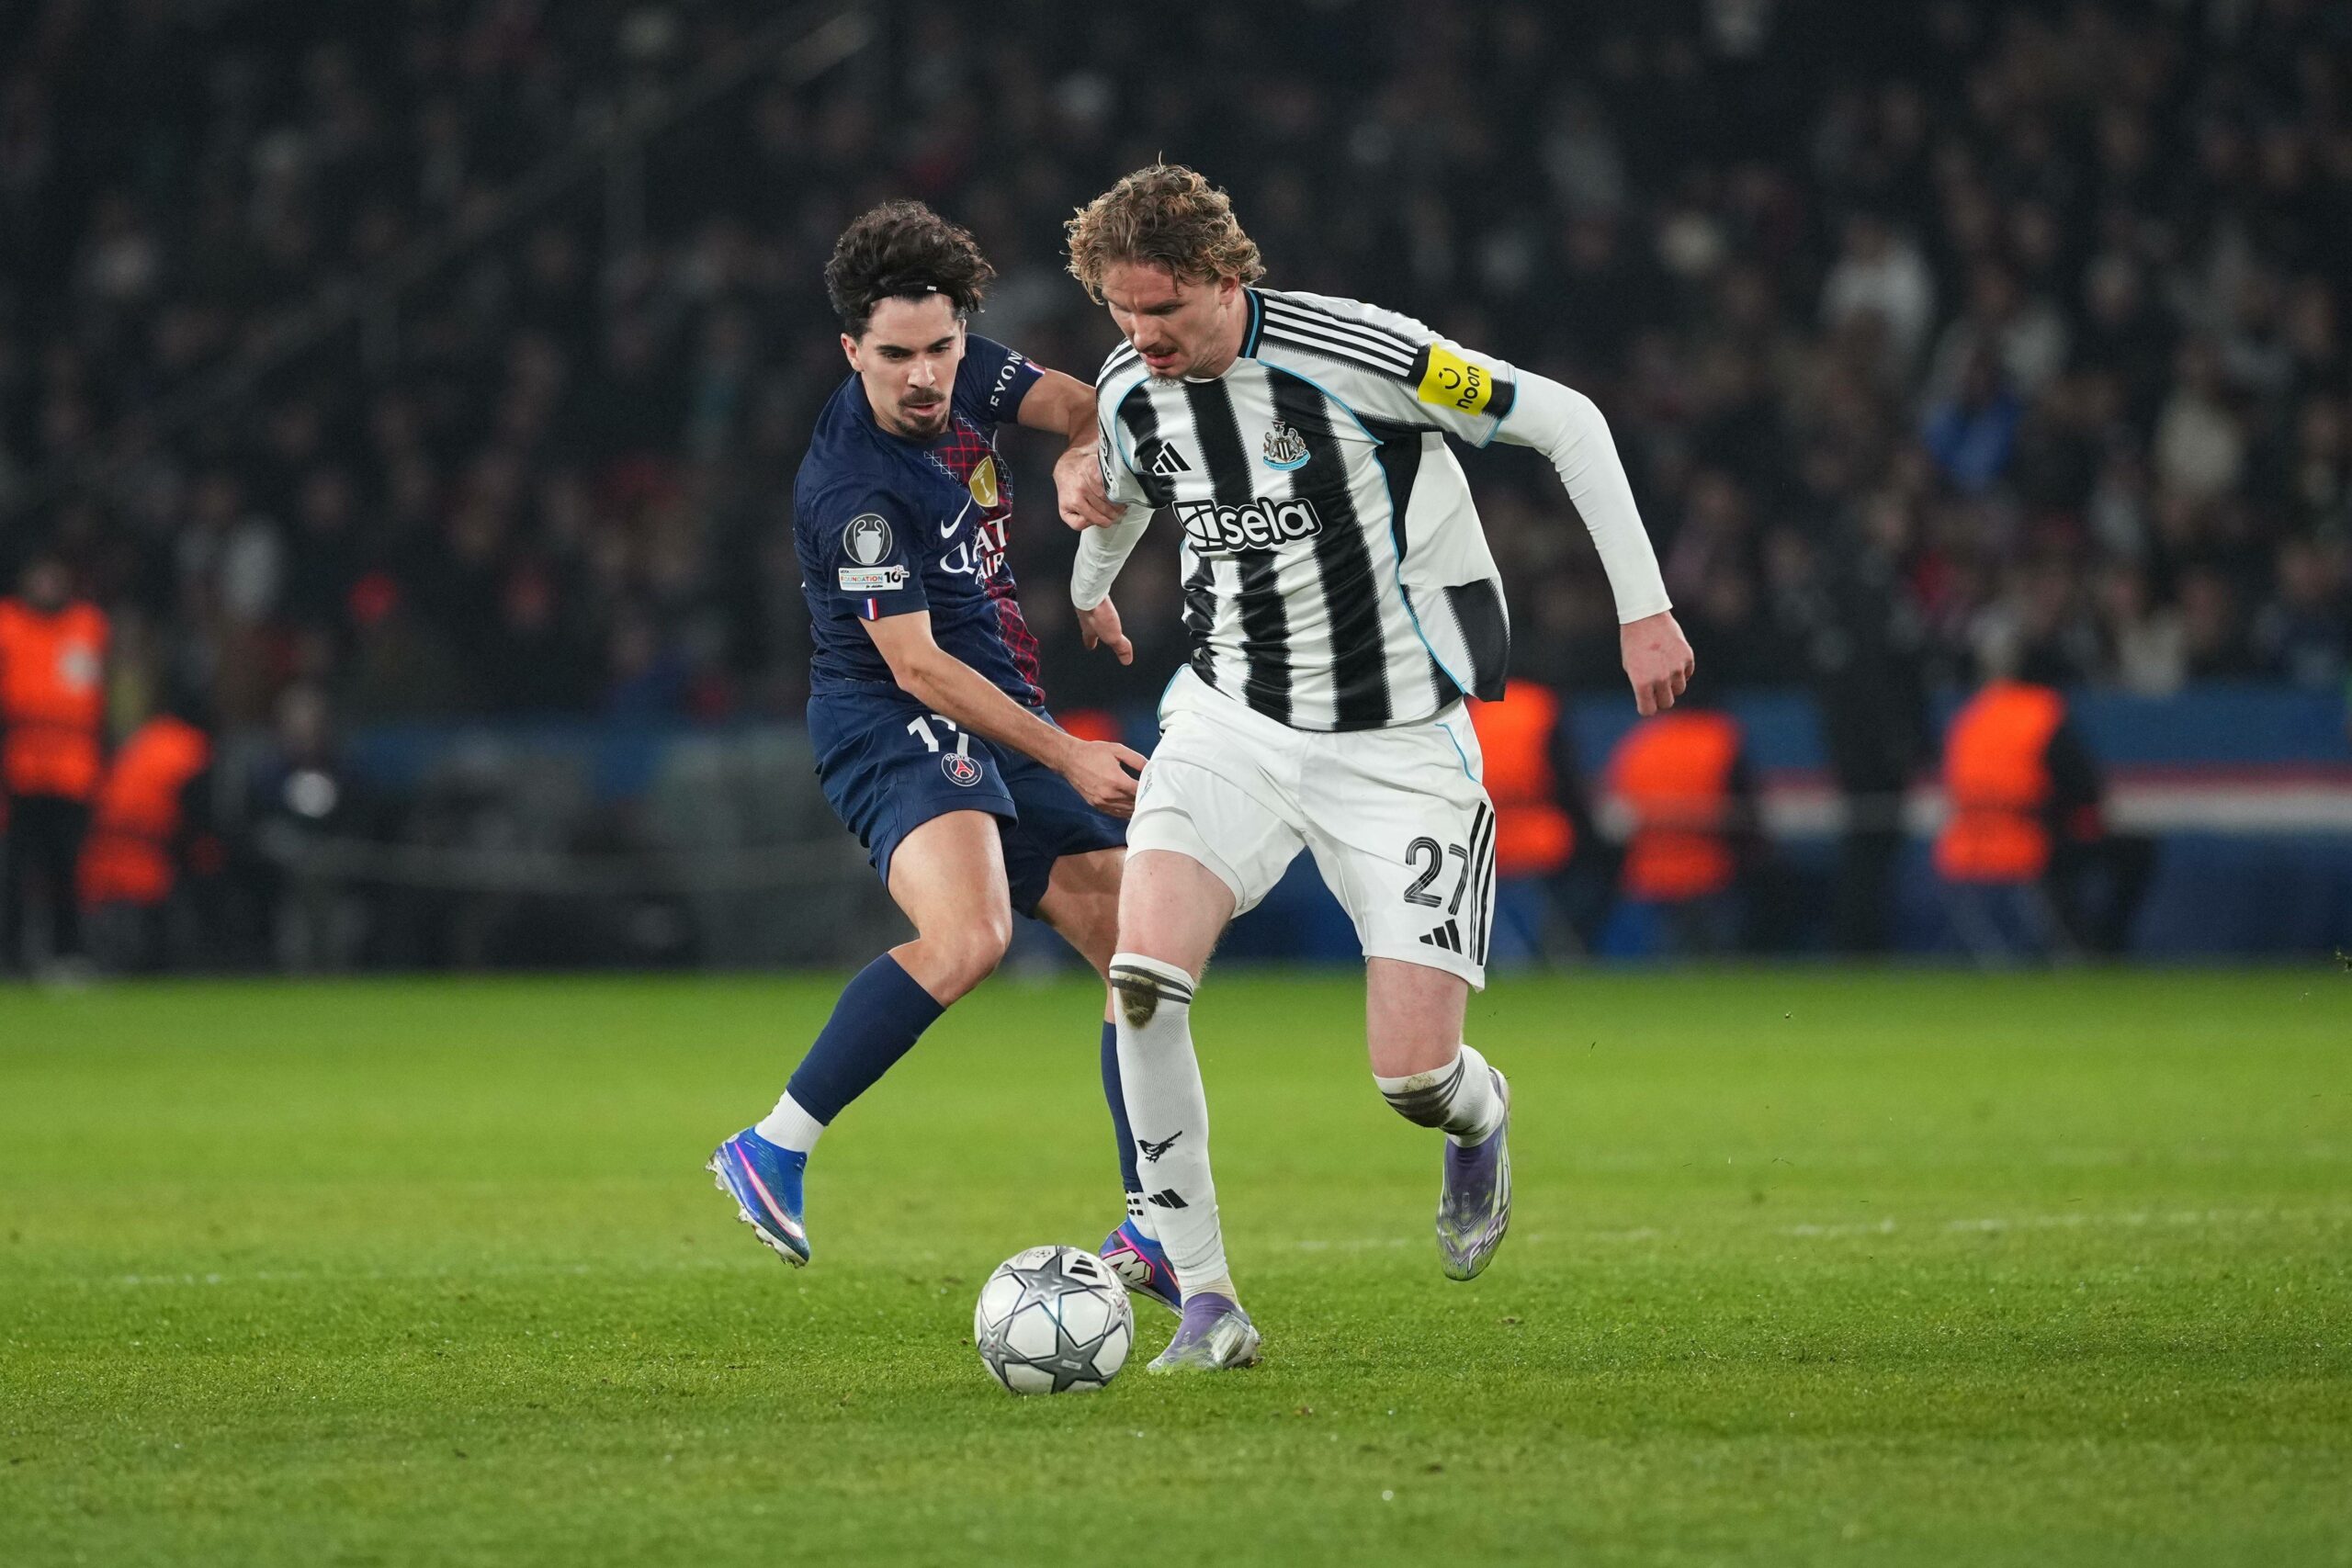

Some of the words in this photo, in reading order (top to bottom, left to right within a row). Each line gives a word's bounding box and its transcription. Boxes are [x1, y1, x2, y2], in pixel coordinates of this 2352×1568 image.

[1455, 366, 1481, 410] noon
[1220, 501, 1316, 545] sela
[906, 714, 969, 758] 17
[1404, 836, 1469, 916] 27
[1467, 1202, 1510, 1271] F50
